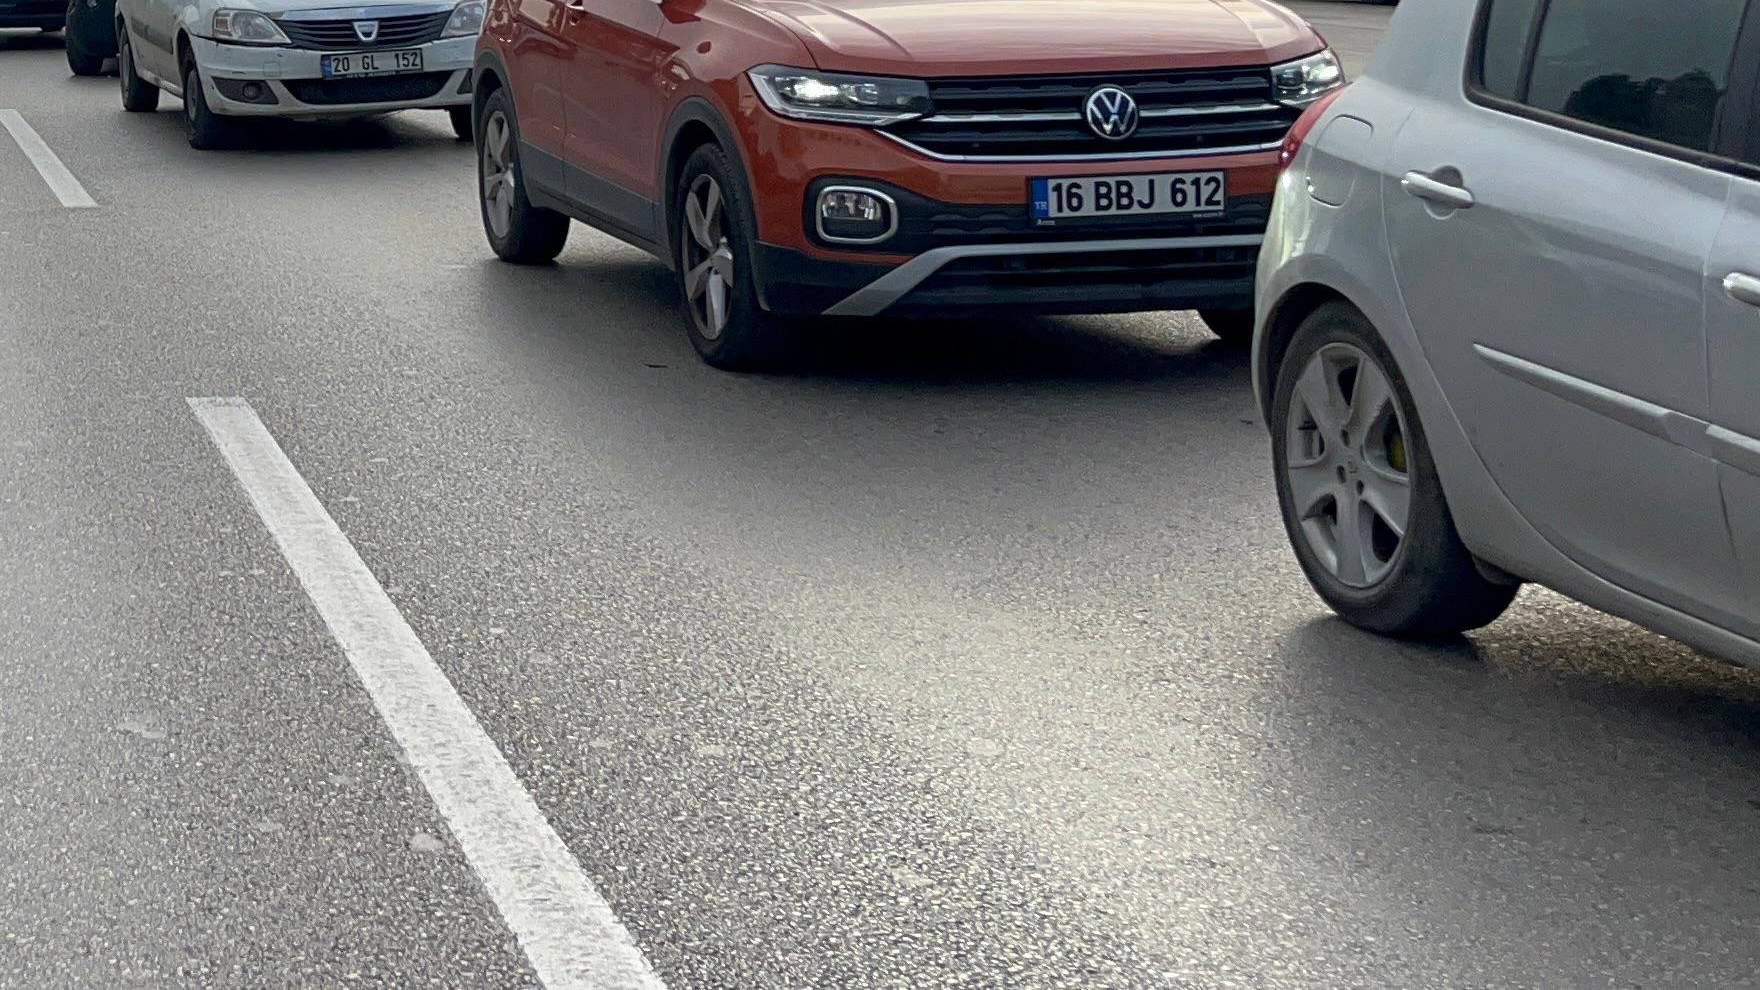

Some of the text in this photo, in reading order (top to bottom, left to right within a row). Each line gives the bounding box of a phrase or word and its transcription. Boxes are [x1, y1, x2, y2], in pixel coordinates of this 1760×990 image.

[333, 52, 419, 72] 20 GL 152
[1052, 176, 1221, 213] 16 BBJ 612
